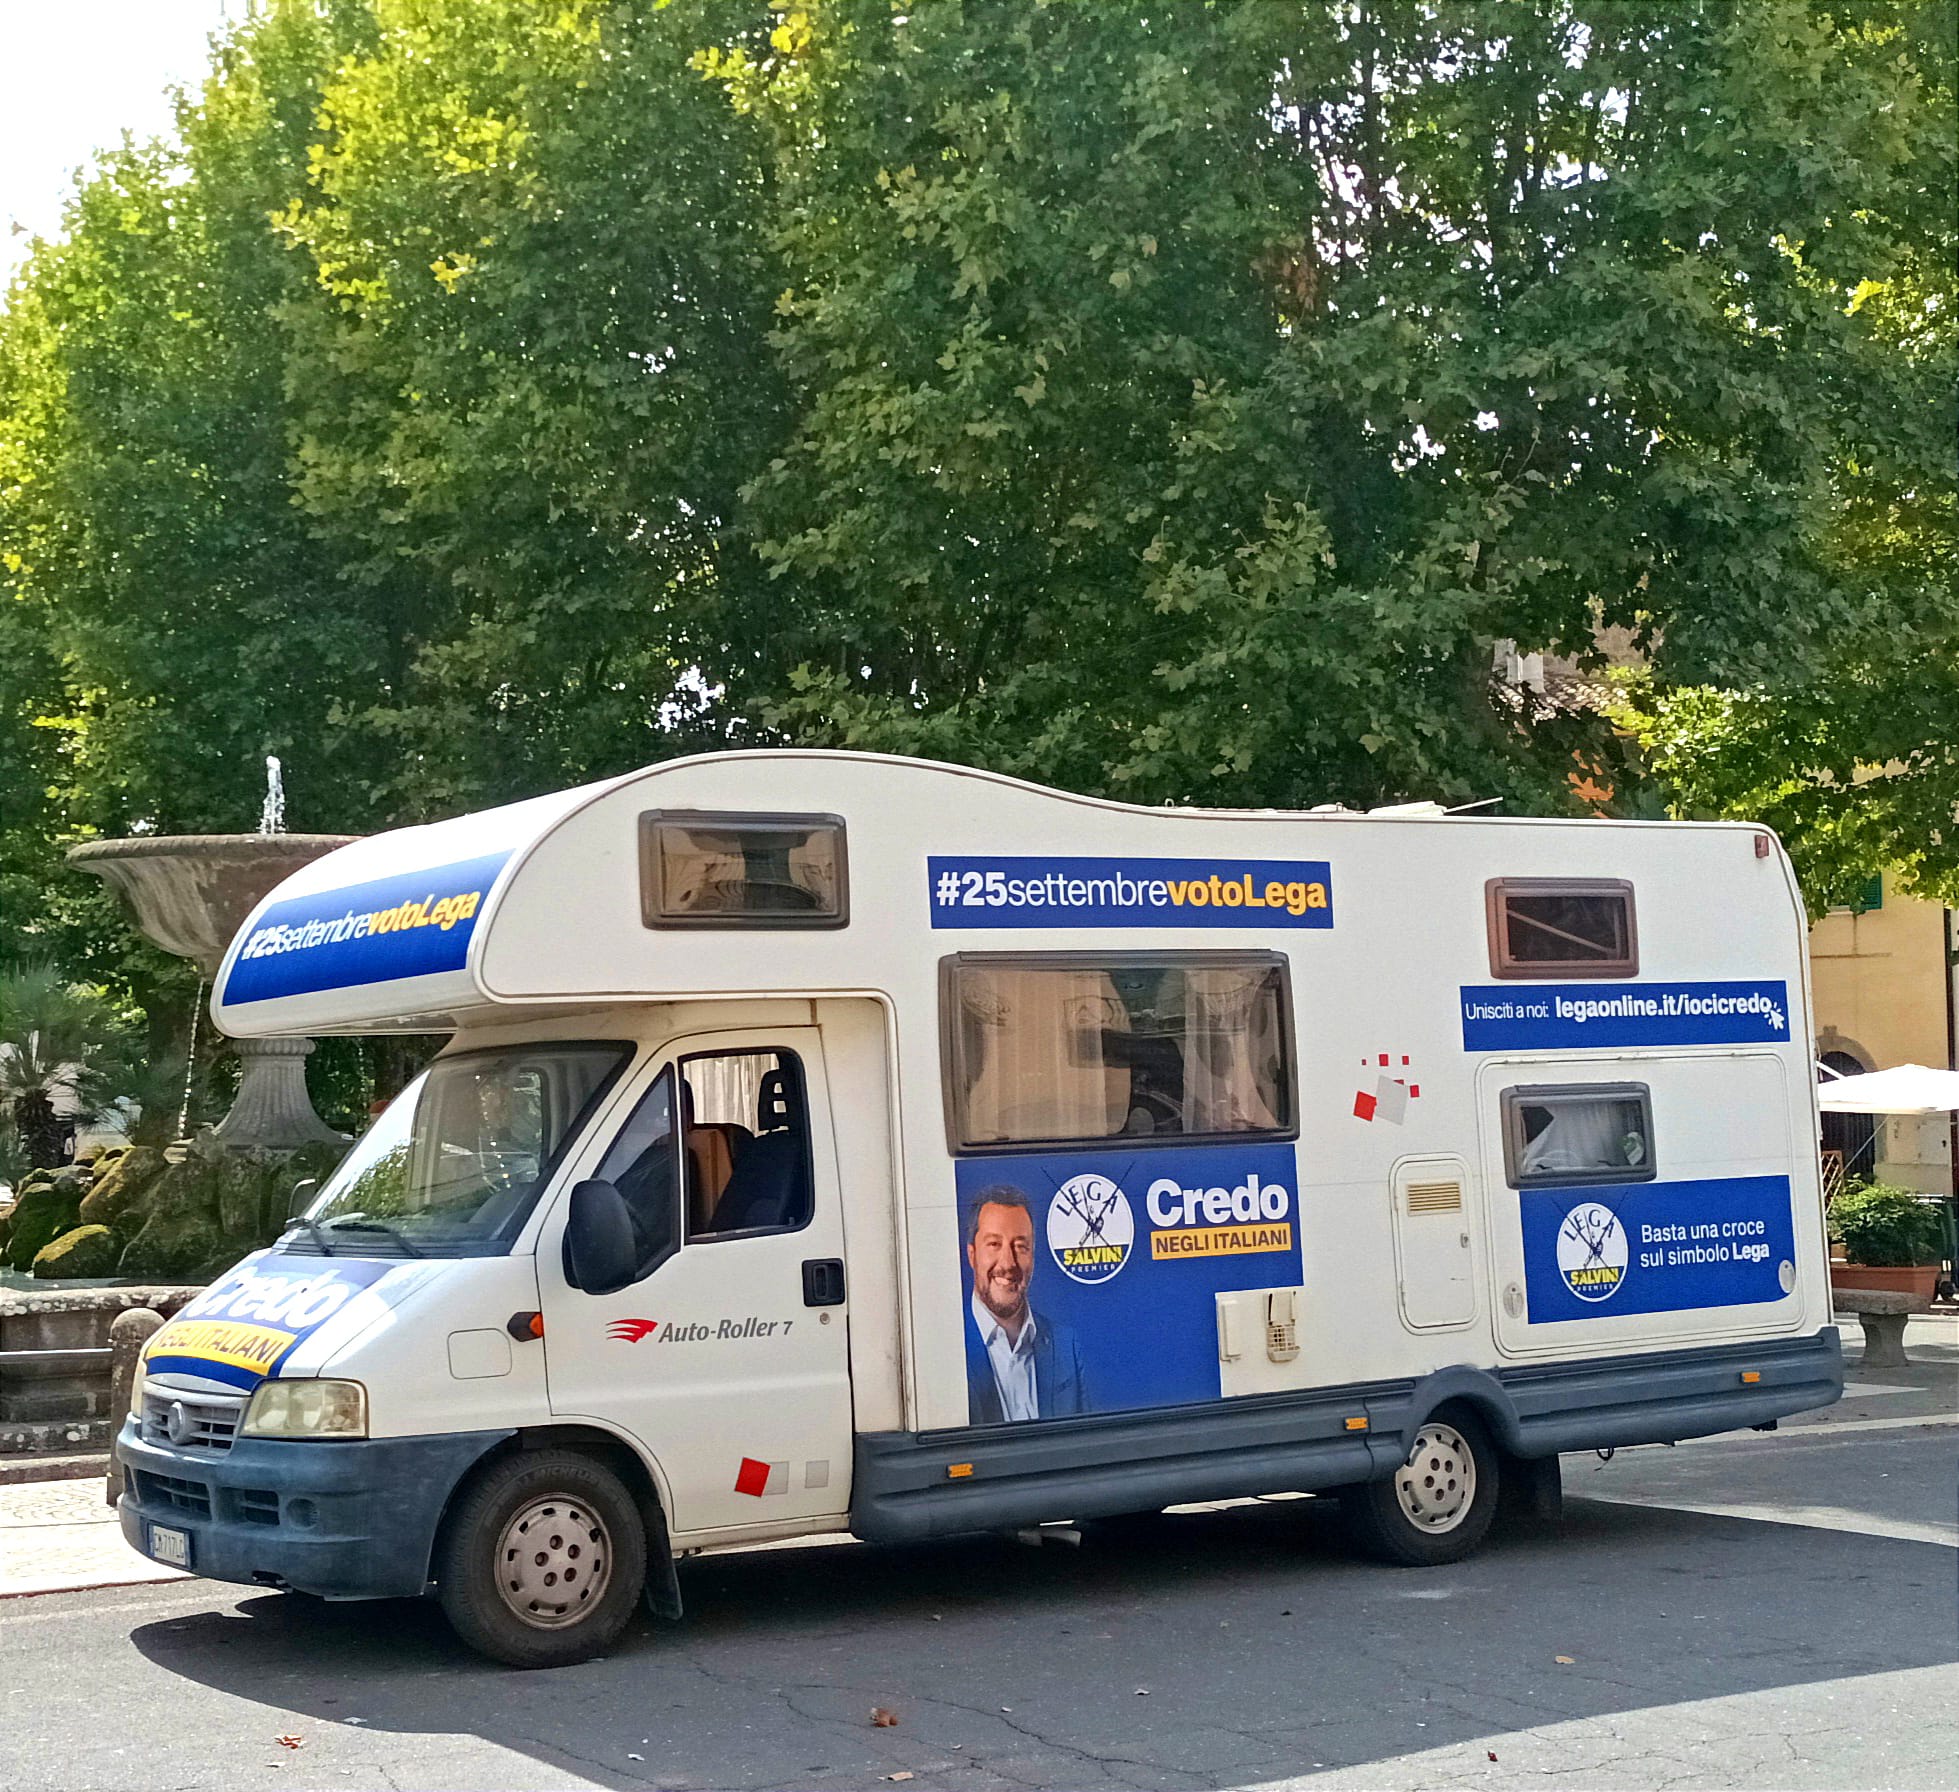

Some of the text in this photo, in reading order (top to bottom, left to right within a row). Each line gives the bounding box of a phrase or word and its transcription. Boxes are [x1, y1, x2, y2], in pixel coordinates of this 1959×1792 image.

[936, 871, 1328, 916] #25settembrevotoLega
[241, 891, 481, 961] #25settembrevotoLega
[1465, 993, 1772, 1022] Unisciti a noi: legaonline.it/iocicredo
[1055, 1180, 1119, 1217] LEGA
[1146, 1174, 1289, 1227] Credo
[1563, 1208, 1615, 1242] LEGA
[1641, 1220, 1765, 1244] Basta una croce
[1063, 1246, 1123, 1266] SALVINI
[1155, 1229, 1288, 1254] NEGLI ITALIANI
[1640, 1242, 1770, 1268] sul simbolo Lega
[1071, 1263, 1116, 1273] PREMIER
[1570, 1268, 1619, 1286] SALVINI
[185, 1266, 350, 1329] Credo
[658, 1317, 793, 1343] Auto-Roller 7
[194, 1328, 285, 1365] ITALIANI
